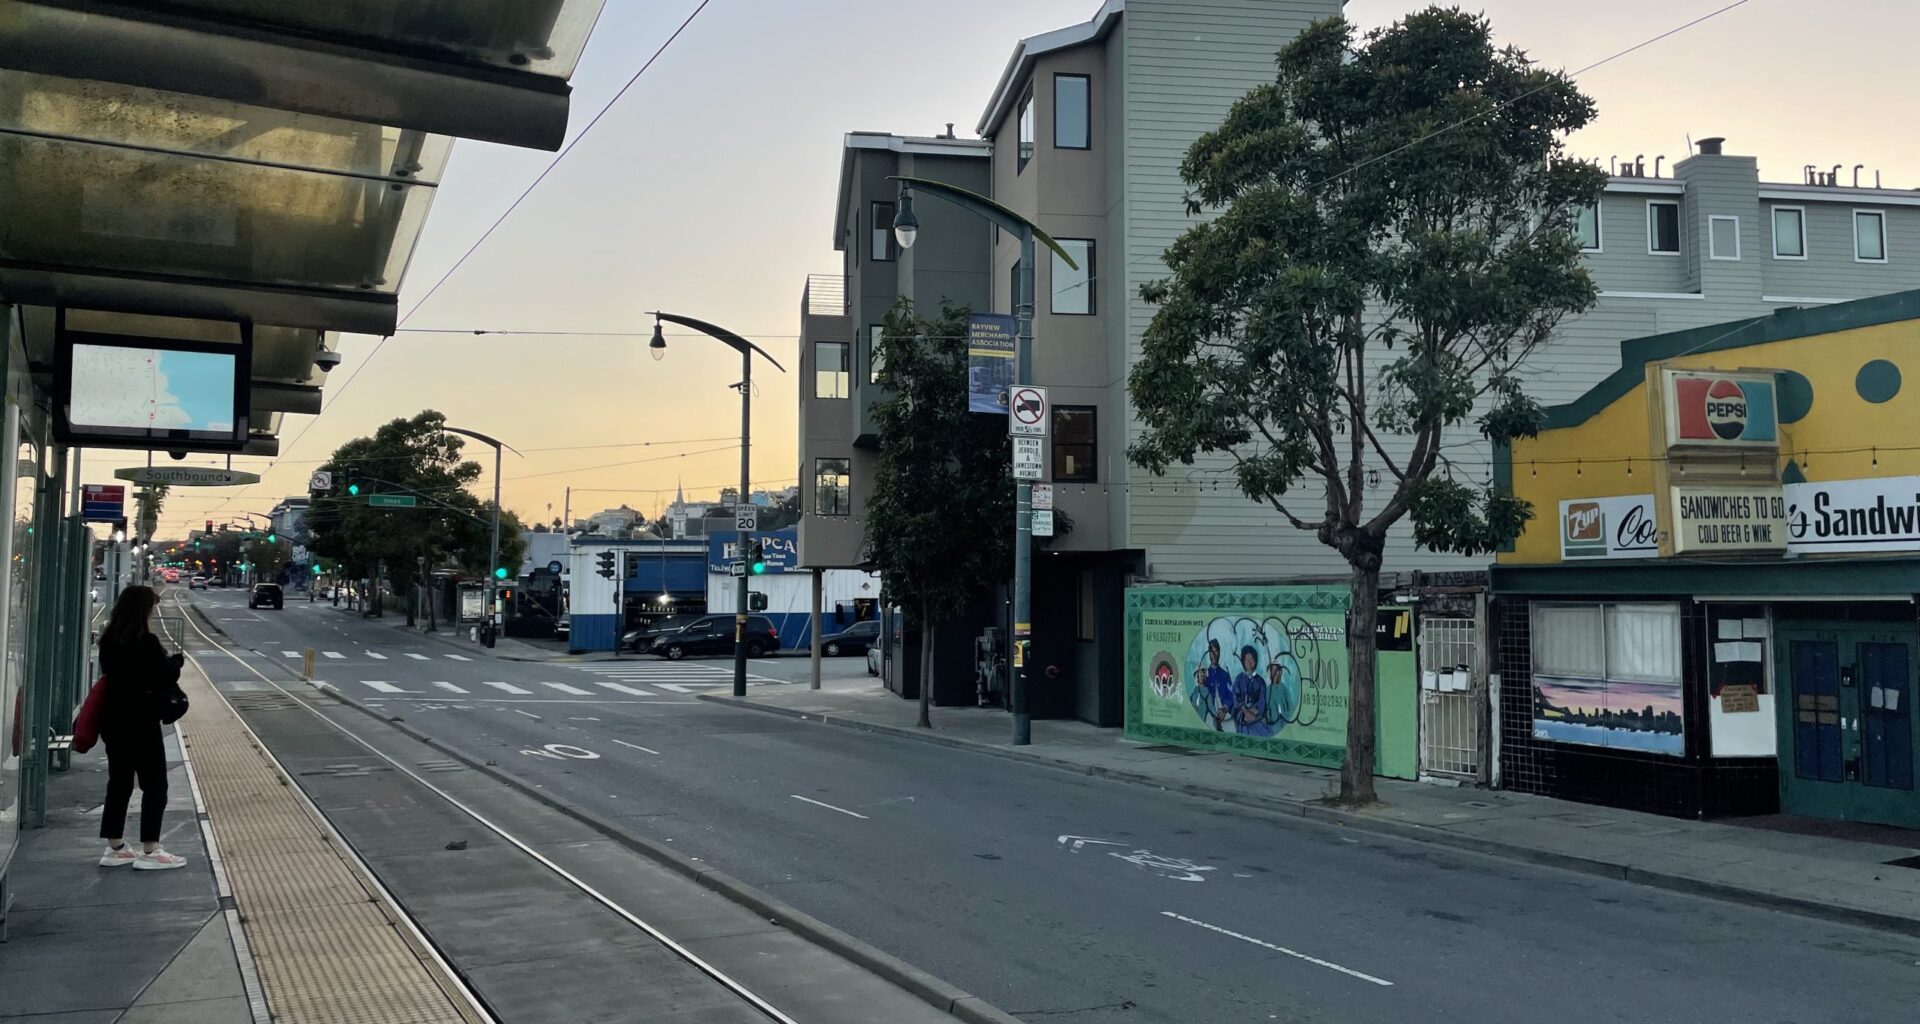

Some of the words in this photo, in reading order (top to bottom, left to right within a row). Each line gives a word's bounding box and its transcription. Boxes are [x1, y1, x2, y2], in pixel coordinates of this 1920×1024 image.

[971, 323, 1001, 331] BAYVIEW
[971, 331, 1009, 340] MERCHANTS
[971, 339, 1014, 348] ASSOCIATION
[1706, 402, 1747, 418] PEPSI
[146, 469, 224, 482] Southbound
[1680, 496, 1751, 519] SANDWICHES
[1752, 496, 1767, 519] TO
[1771, 496, 1785, 519] GO
[1032, 511, 1038, 519] 2
[737, 518, 755, 529] 20
[1698, 524, 1719, 544] COLD
[1721, 524, 1742, 544] BEER
[1744, 524, 1750, 543] &
[1751, 524, 1772, 543] WINE
[1309, 658, 1339, 690] 100
